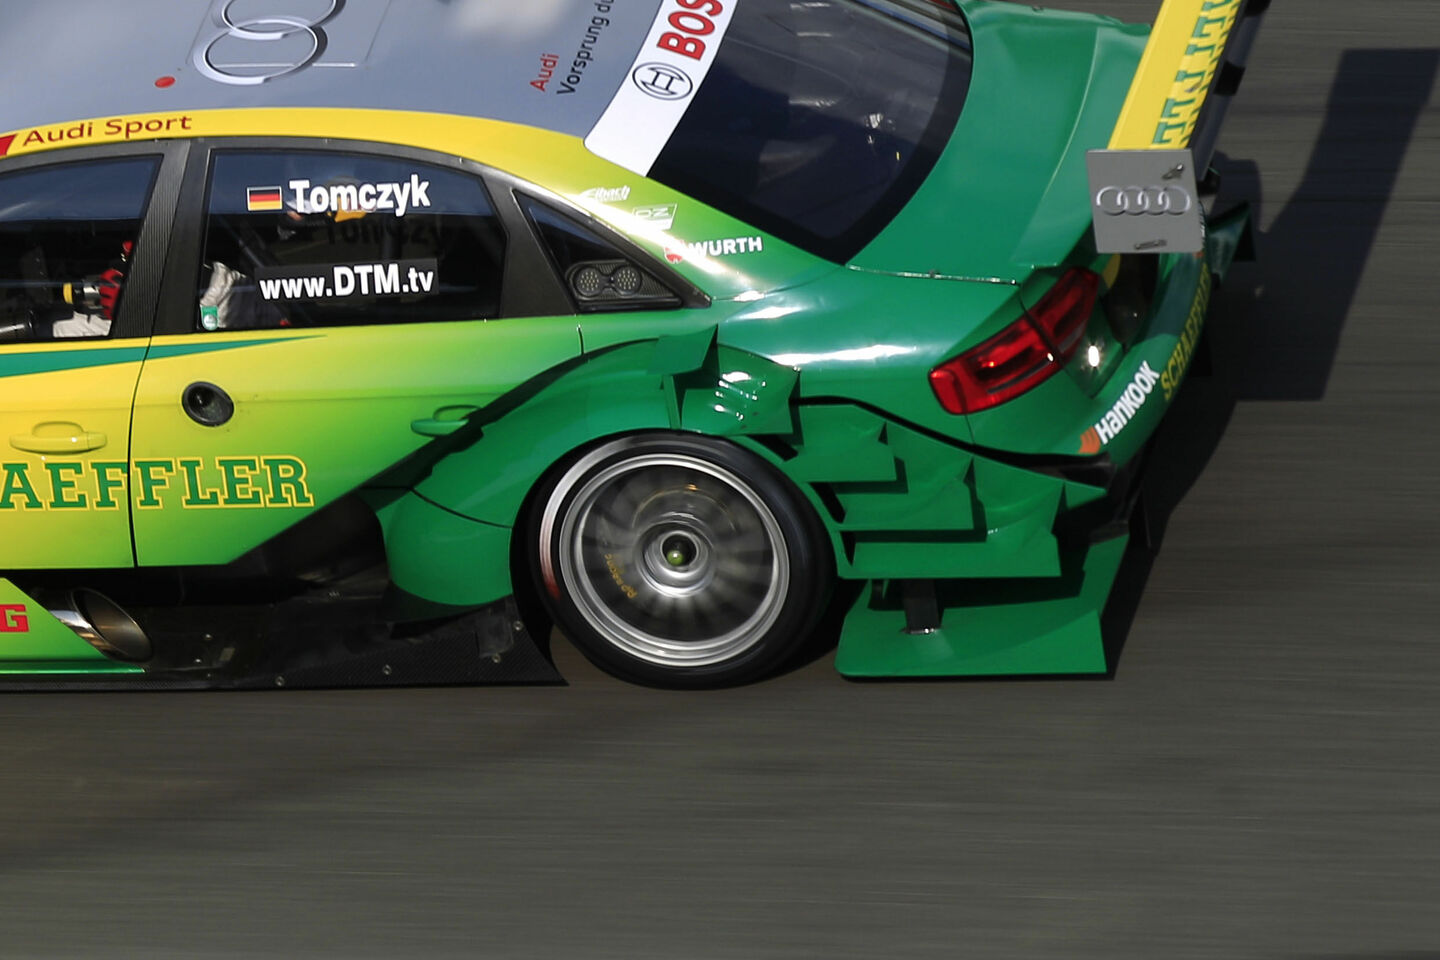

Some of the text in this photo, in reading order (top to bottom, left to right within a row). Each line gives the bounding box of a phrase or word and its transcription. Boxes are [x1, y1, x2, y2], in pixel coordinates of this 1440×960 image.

[529, 53, 560, 92] Audi
[556, 14, 610, 95] Vorsprung
[22, 115, 193, 147] Audi Sport
[289, 174, 431, 217] Tomczyk
[260, 263, 434, 300] www.DTM.tv
